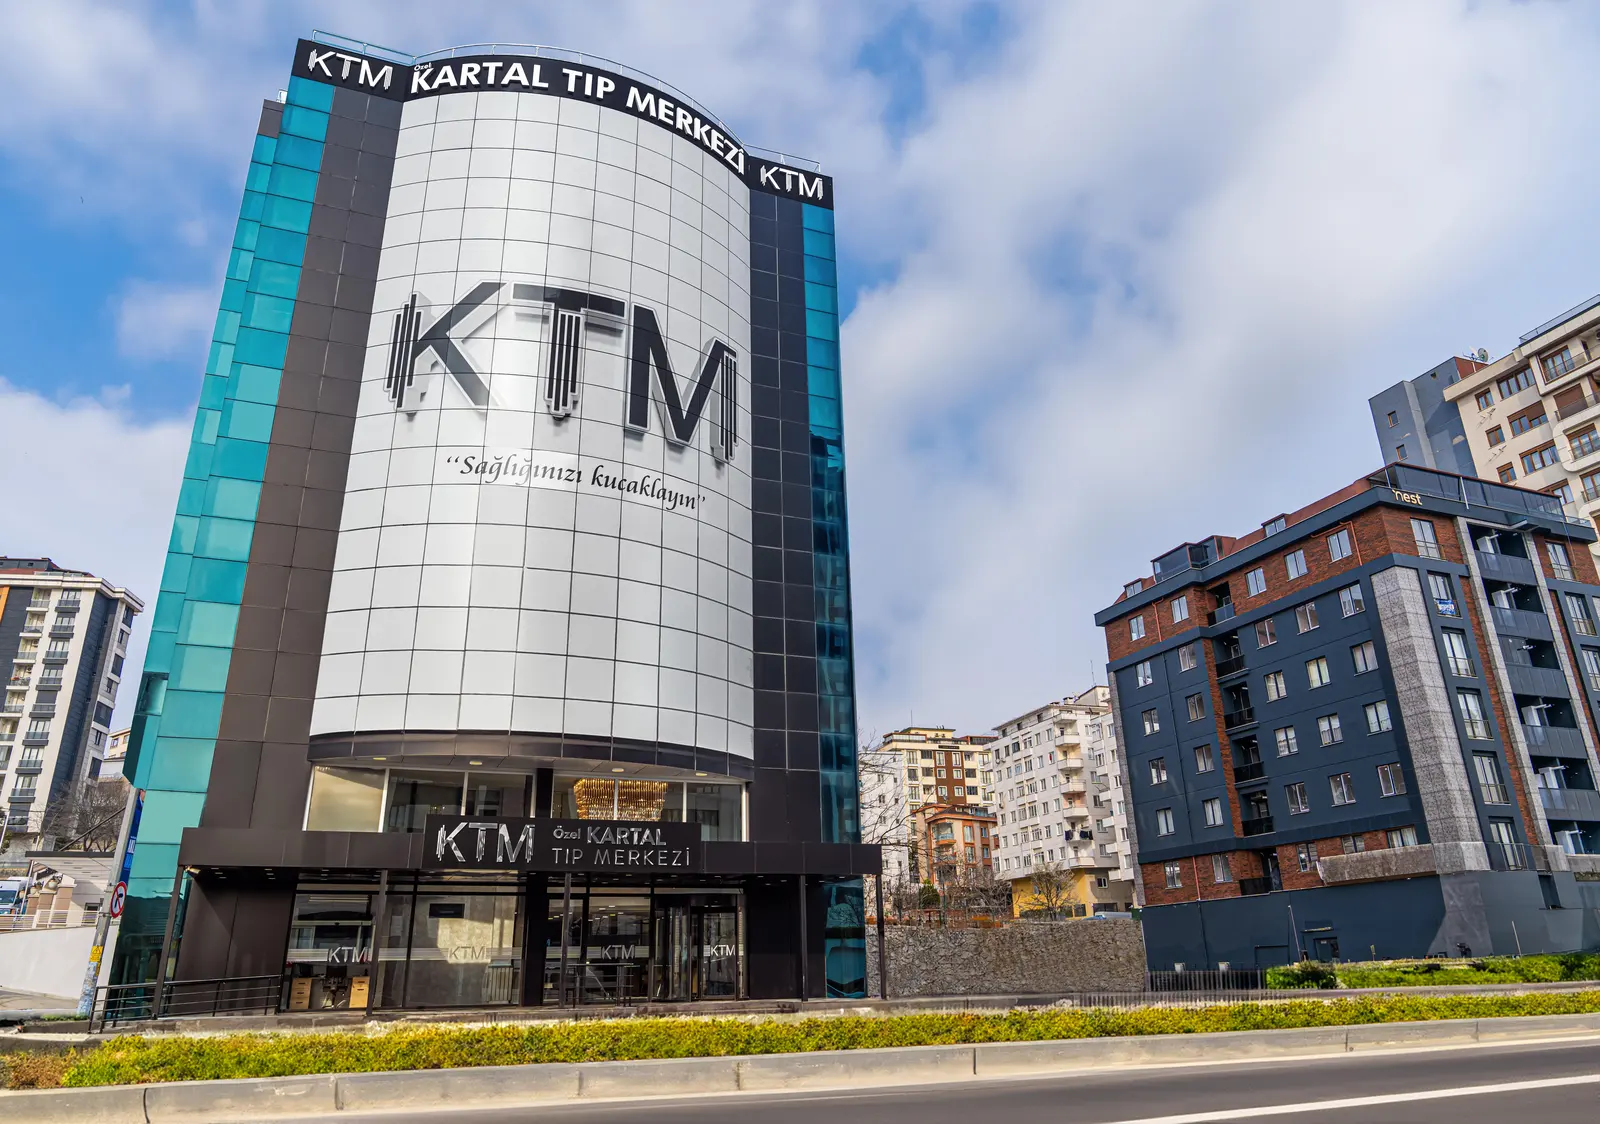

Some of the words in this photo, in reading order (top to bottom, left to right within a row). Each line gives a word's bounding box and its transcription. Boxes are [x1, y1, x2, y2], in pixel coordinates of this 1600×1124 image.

[307, 49, 393, 91] KTM
[414, 62, 432, 72] Özel
[411, 61, 549, 94] KARTAL
[562, 68, 616, 99] TIP
[626, 86, 745, 175] MERKEZİ
[760, 165, 824, 200] KTM
[383, 280, 739, 463] KTM
[1392, 489, 1423, 506] nest
[436, 822, 536, 863] KTM
[553, 825, 581, 839] Özel
[587, 826, 667, 846] KARTAL
[552, 847, 584, 865] TIP
[594, 847, 690, 866] MERKEZİ
[328, 946, 369, 963] KTM
[449, 946, 486, 961] KTM
[601, 944, 635, 960] KTM
[710, 944, 736, 957] KTM
